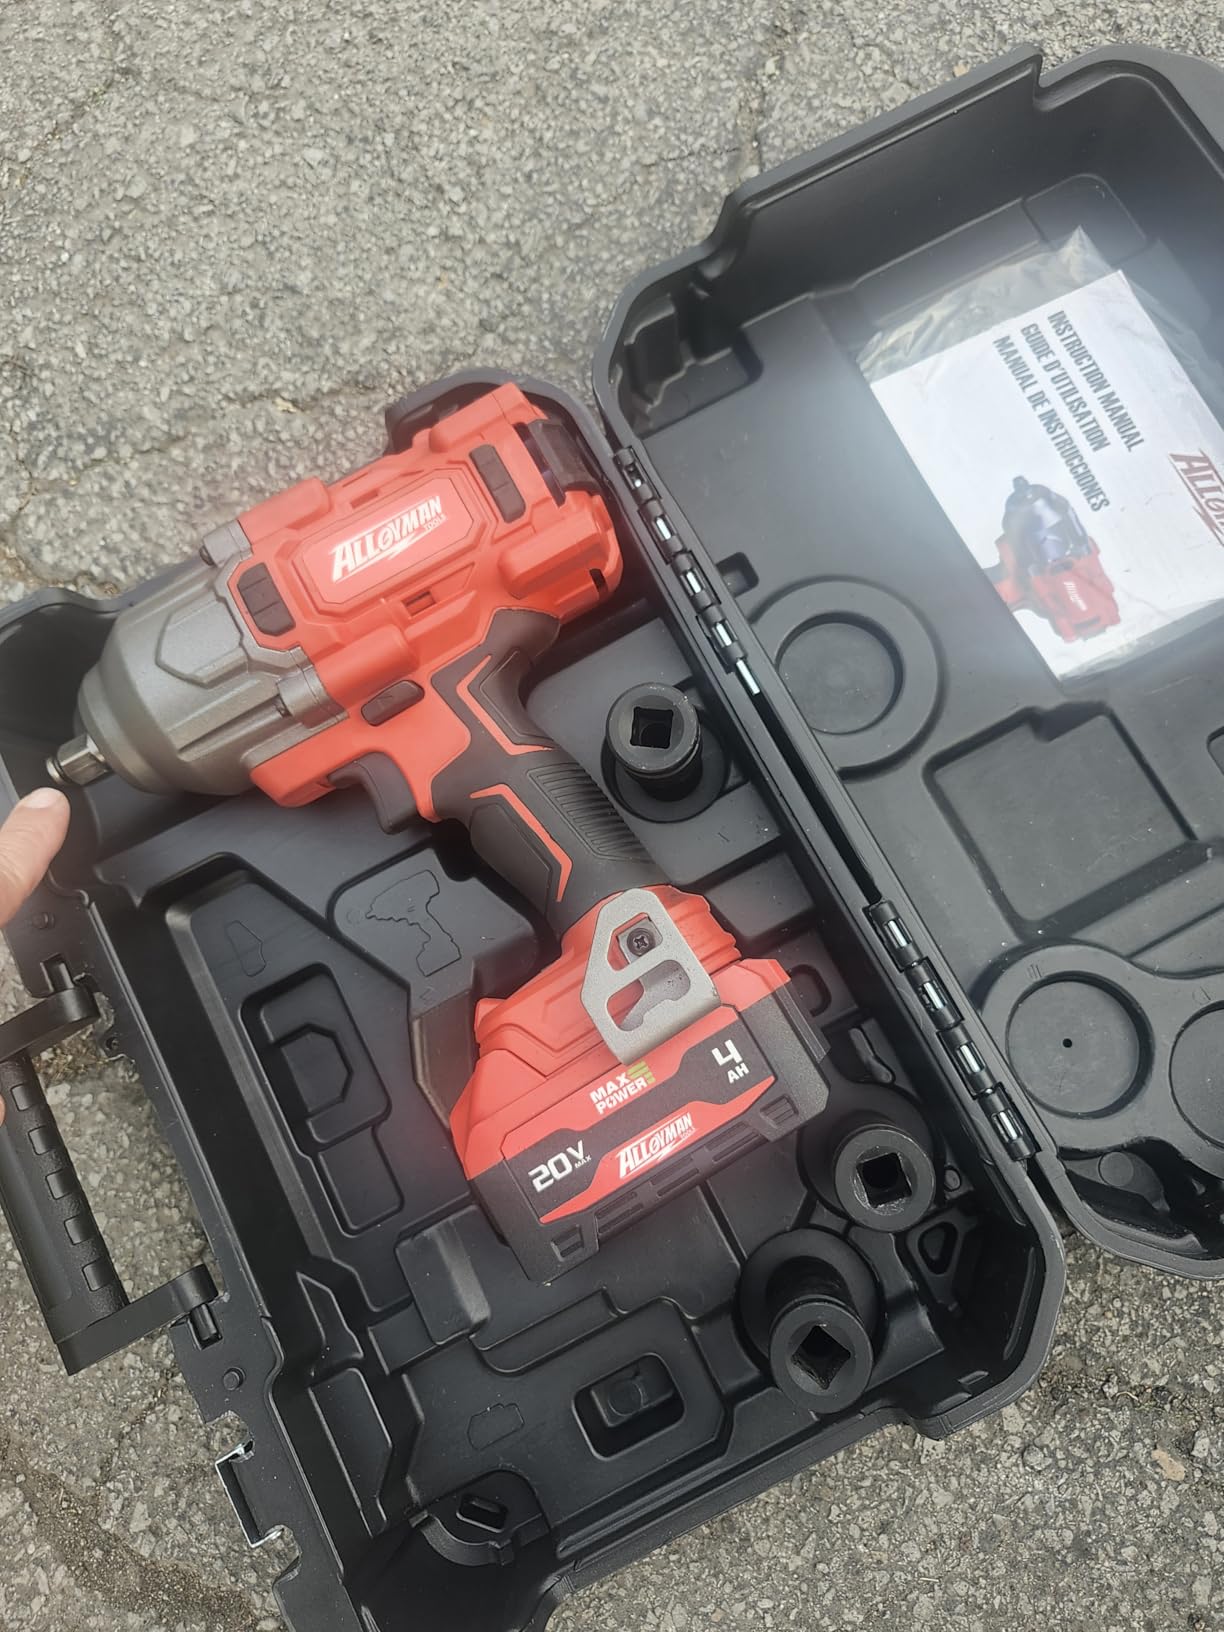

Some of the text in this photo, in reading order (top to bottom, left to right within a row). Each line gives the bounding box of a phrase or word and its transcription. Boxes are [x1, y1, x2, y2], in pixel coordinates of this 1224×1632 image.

[1021, 323, 1111, 452] GUIDE D'UTILISATION
[1048, 310, 1144, 452] INSTRUCTION MANUAL
[992, 335, 1110, 512] MANUAL DE INSTRUCCIONES
[331, 494, 442, 583] ALLOYMAN
[711, 1039, 743, 1066] 4
[727, 1063, 749, 1084] AH
[589, 1072, 630, 1104] MAX
[594, 1077, 648, 1114] POWER
[574, 1154, 592, 1168] MAX
[616, 1112, 693, 1179] ALLOYMAN
